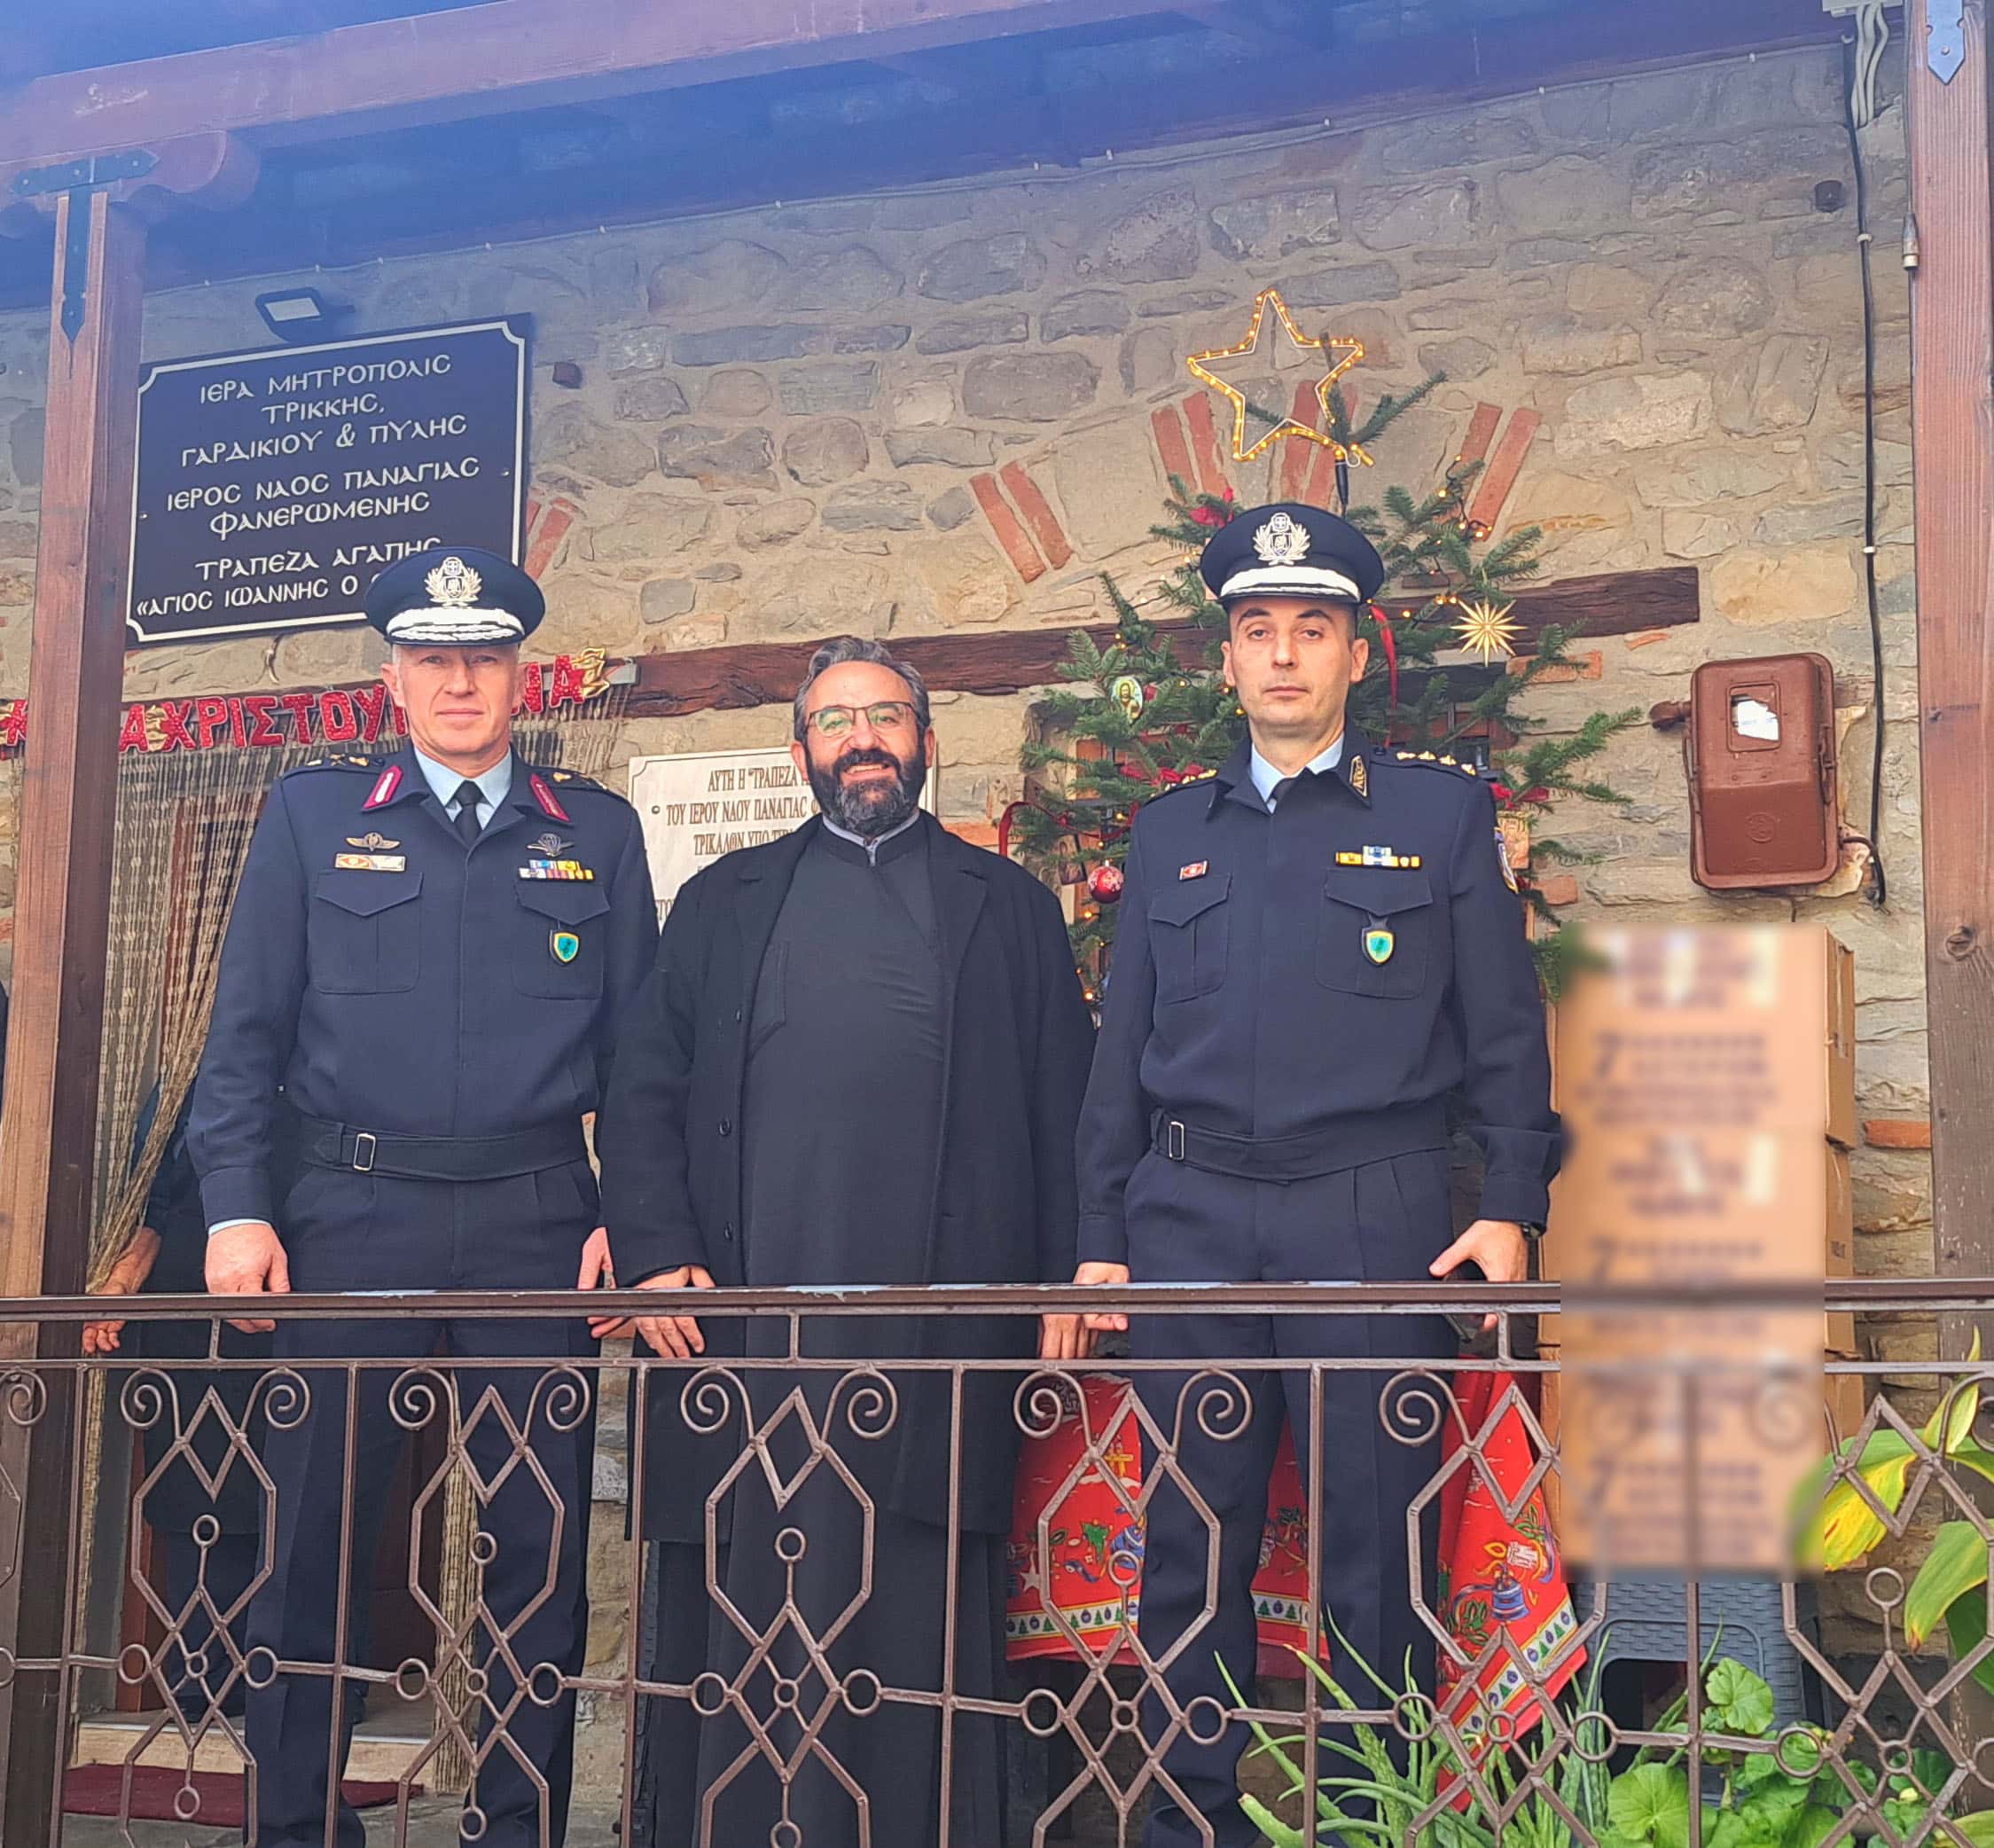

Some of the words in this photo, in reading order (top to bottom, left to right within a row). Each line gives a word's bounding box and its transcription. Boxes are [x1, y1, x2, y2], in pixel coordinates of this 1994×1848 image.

[200, 380, 254, 404] ΙΕΡΑ
[182, 430, 324, 467] ΓΑΡΔΙΚΙΟΥ
[335, 422, 356, 448] &
[194, 550, 320, 581] ΤΡΑΠΕΖΑ
[708, 769, 735, 792] ΑΥΤΗ
[737, 768, 746, 790] Η
[666, 803, 686, 826] ΤΟΥ
[689, 801, 719, 825] ΙΕΡΟΥ
[722, 799, 750, 823] ΝΑΟΥ
